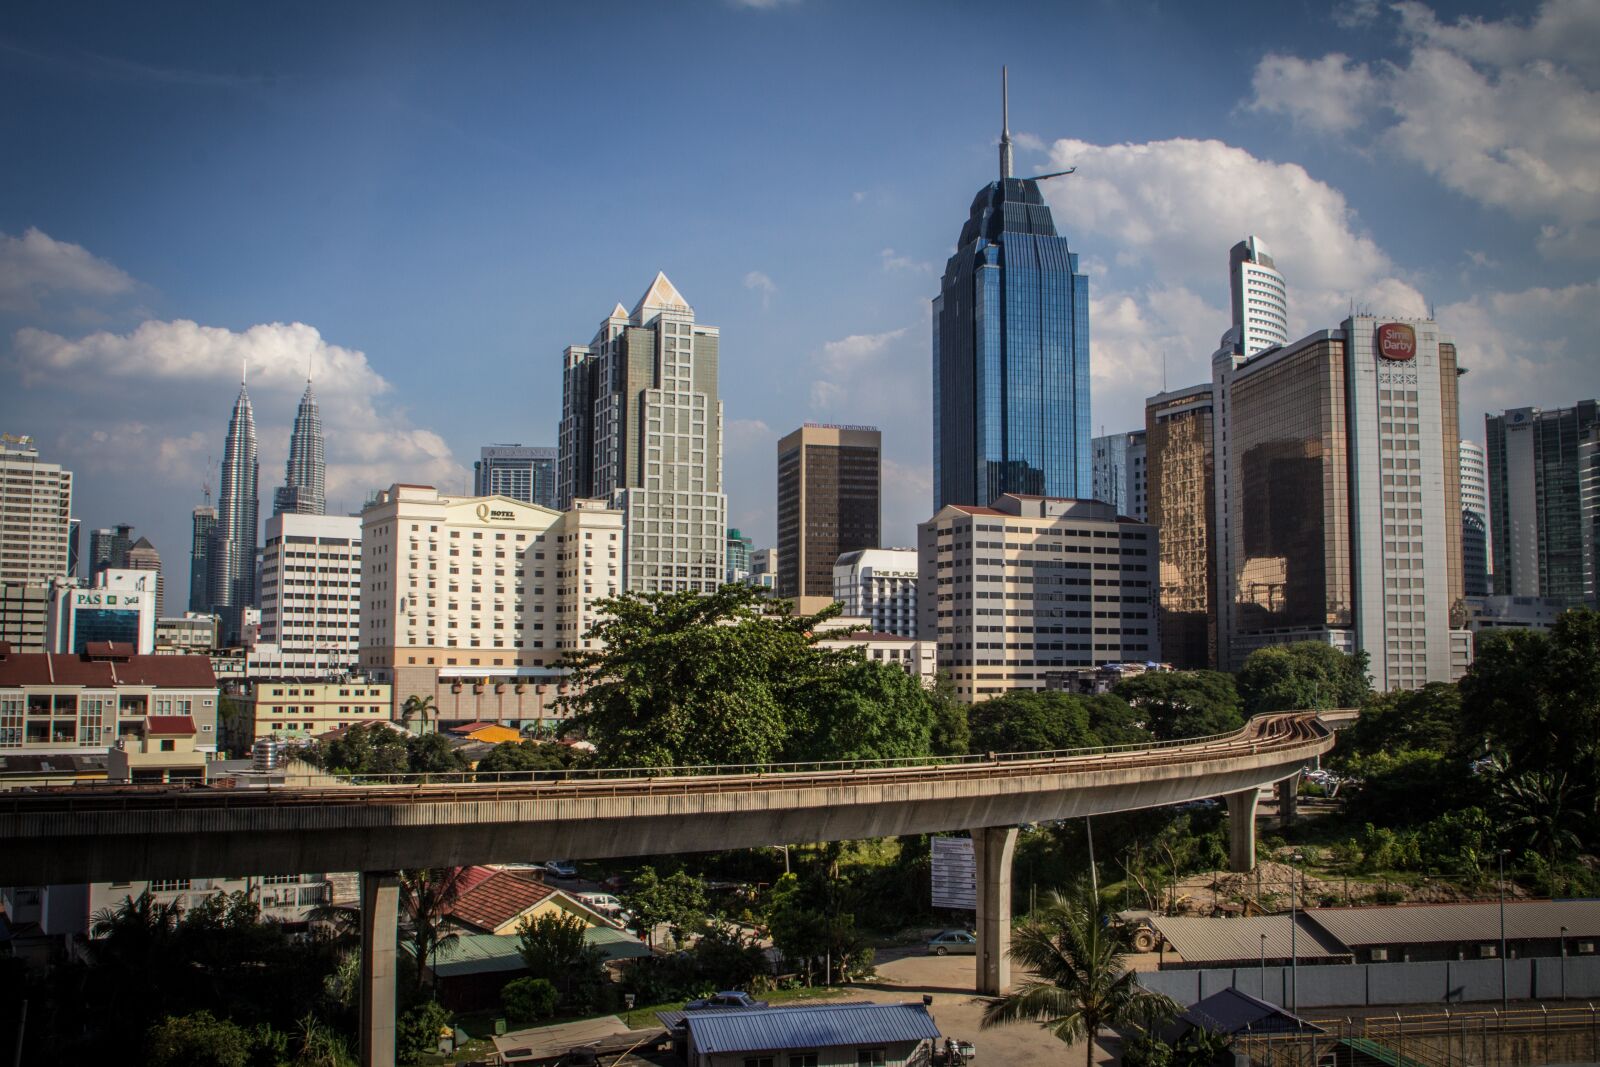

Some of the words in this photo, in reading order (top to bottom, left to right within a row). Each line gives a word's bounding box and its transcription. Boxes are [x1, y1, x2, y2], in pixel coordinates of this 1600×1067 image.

[1384, 339, 1413, 353] Darby
[476, 503, 490, 523] Q
[78, 594, 102, 604] PAS
